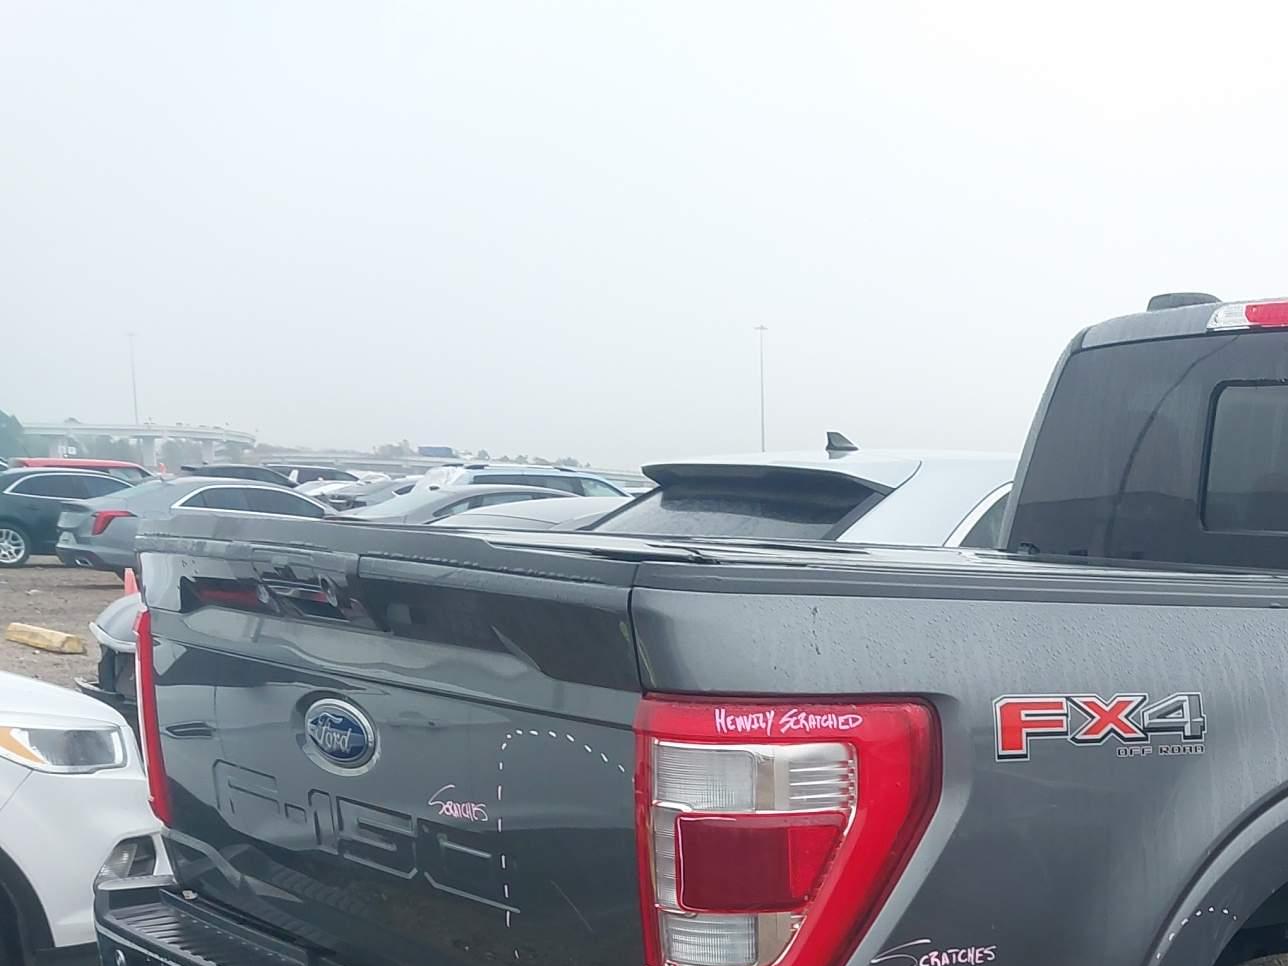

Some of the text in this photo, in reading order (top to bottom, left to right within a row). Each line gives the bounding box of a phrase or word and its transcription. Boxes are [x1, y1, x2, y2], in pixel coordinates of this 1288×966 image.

[313, 711, 352, 753] Ford
[993, 692, 1207, 762] FX4
[1117, 744, 1205, 757] OFF ROAD
